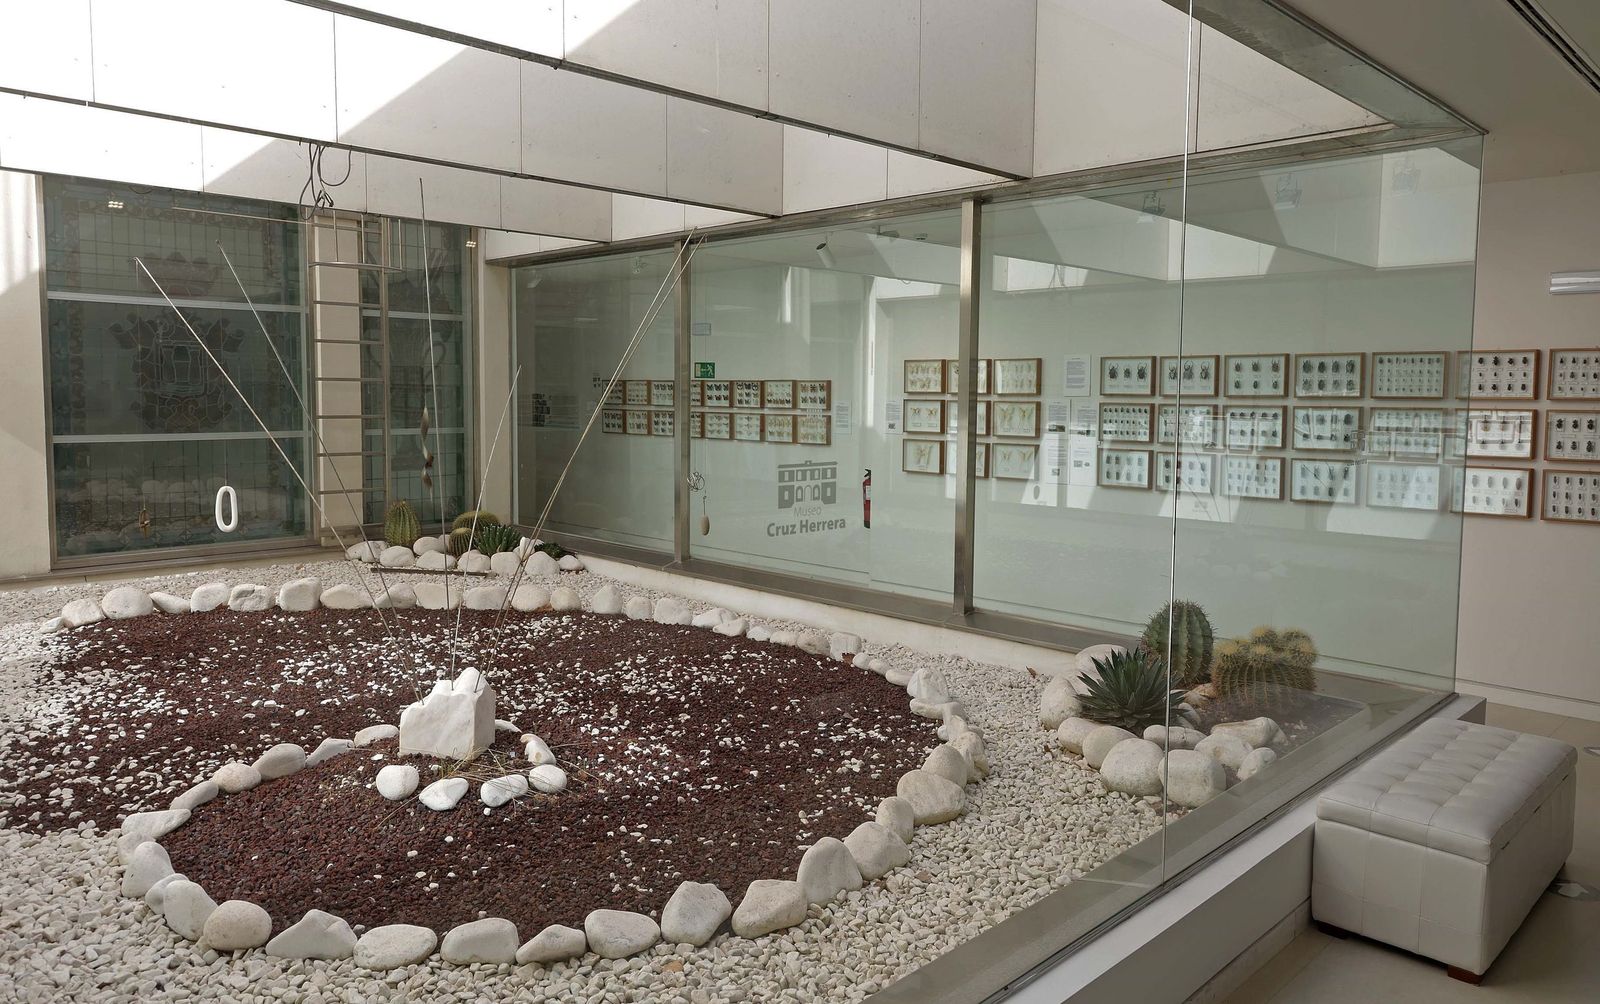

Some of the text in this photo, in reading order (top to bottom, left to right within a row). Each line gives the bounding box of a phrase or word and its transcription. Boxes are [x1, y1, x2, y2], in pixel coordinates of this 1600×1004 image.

[794, 507, 822, 517] Museo
[767, 519, 846, 537] Cruz Herrera
